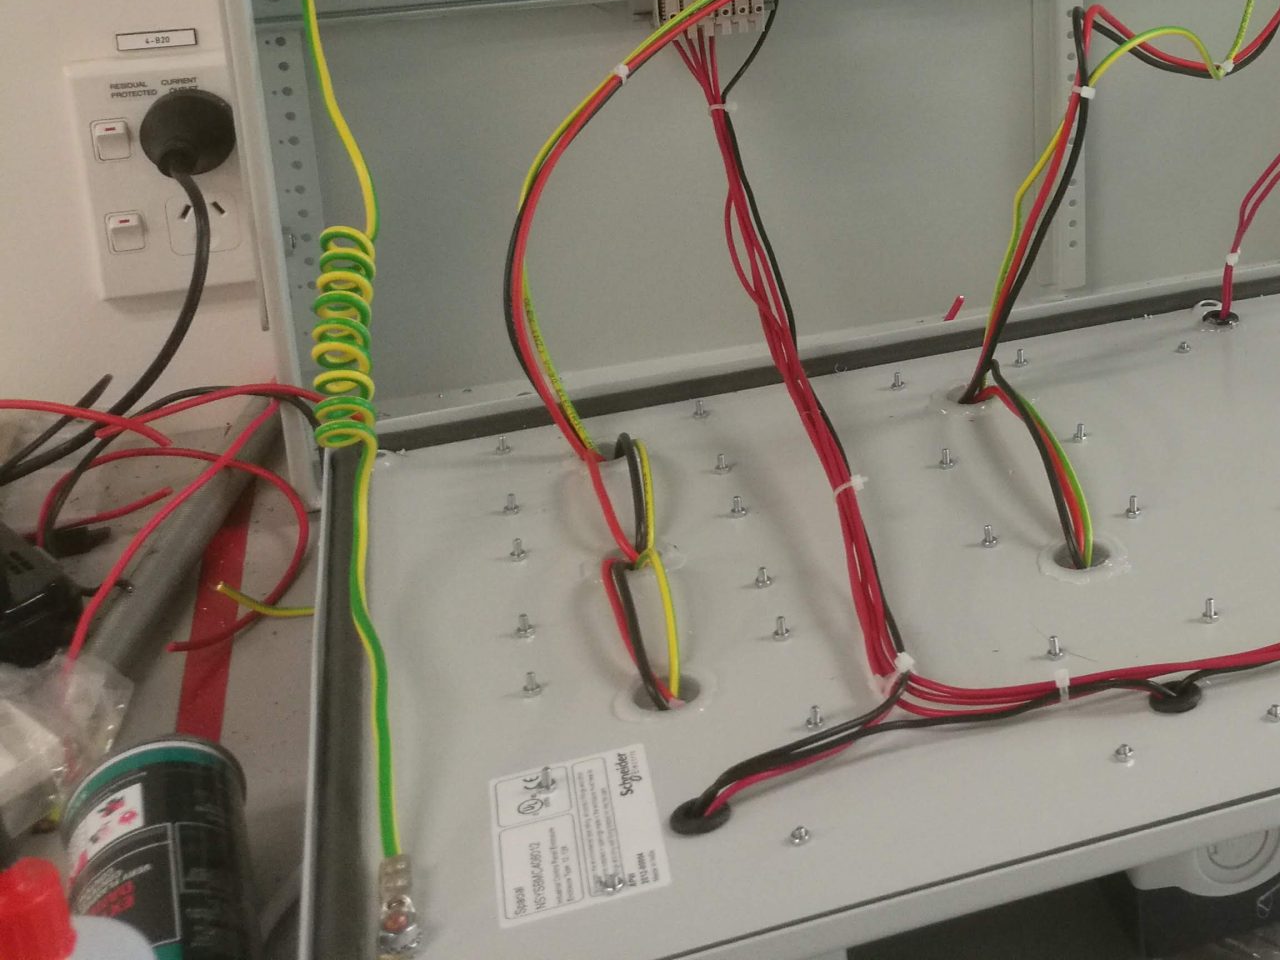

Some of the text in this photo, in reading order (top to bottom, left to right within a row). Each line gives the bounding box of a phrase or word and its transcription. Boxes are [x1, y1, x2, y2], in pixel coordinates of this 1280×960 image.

[110, 77, 197, 90] RESIDUAL CURRENT
[111, 88, 157, 98] PROTECTED
[615, 753, 643, 796] Schneider
